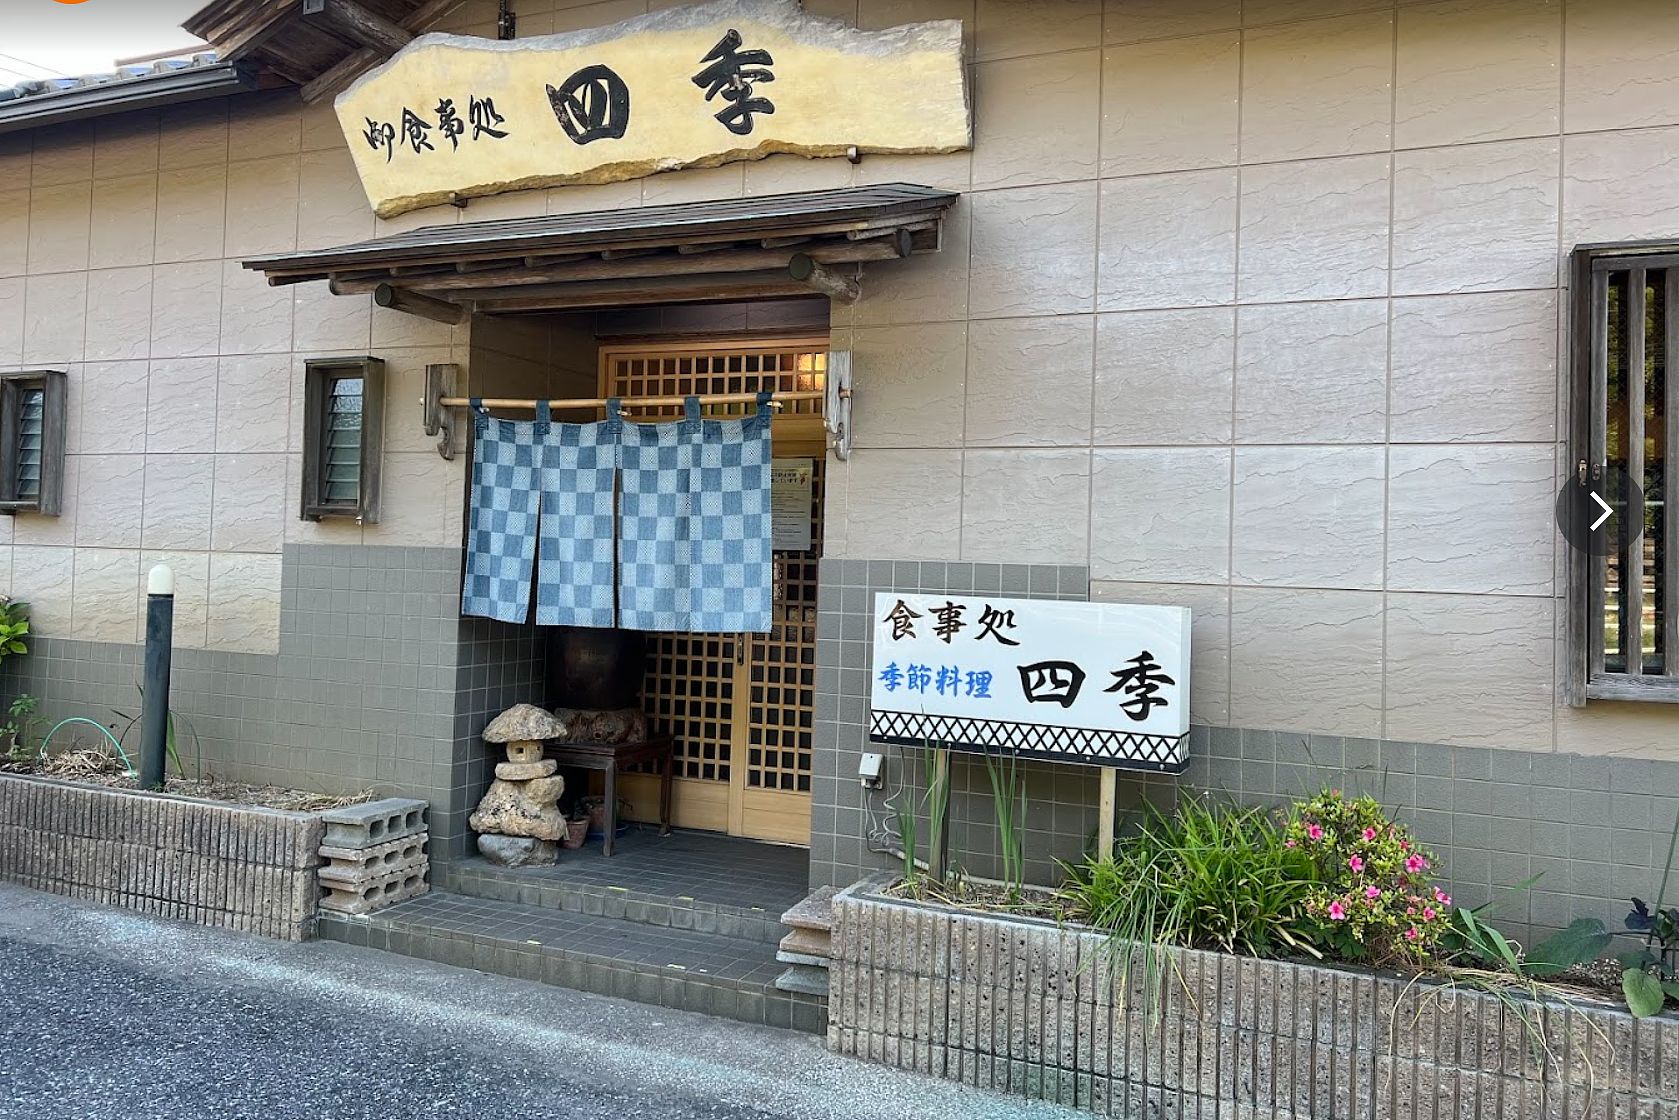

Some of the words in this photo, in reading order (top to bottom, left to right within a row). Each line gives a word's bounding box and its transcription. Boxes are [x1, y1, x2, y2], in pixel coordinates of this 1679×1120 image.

[362, 94, 510, 163] 御食事処
[546, 28, 776, 146] 四季
[883, 600, 1021, 646] 食事処
[877, 661, 993, 699] 季節料理
[1016, 650, 1176, 721] 四季
